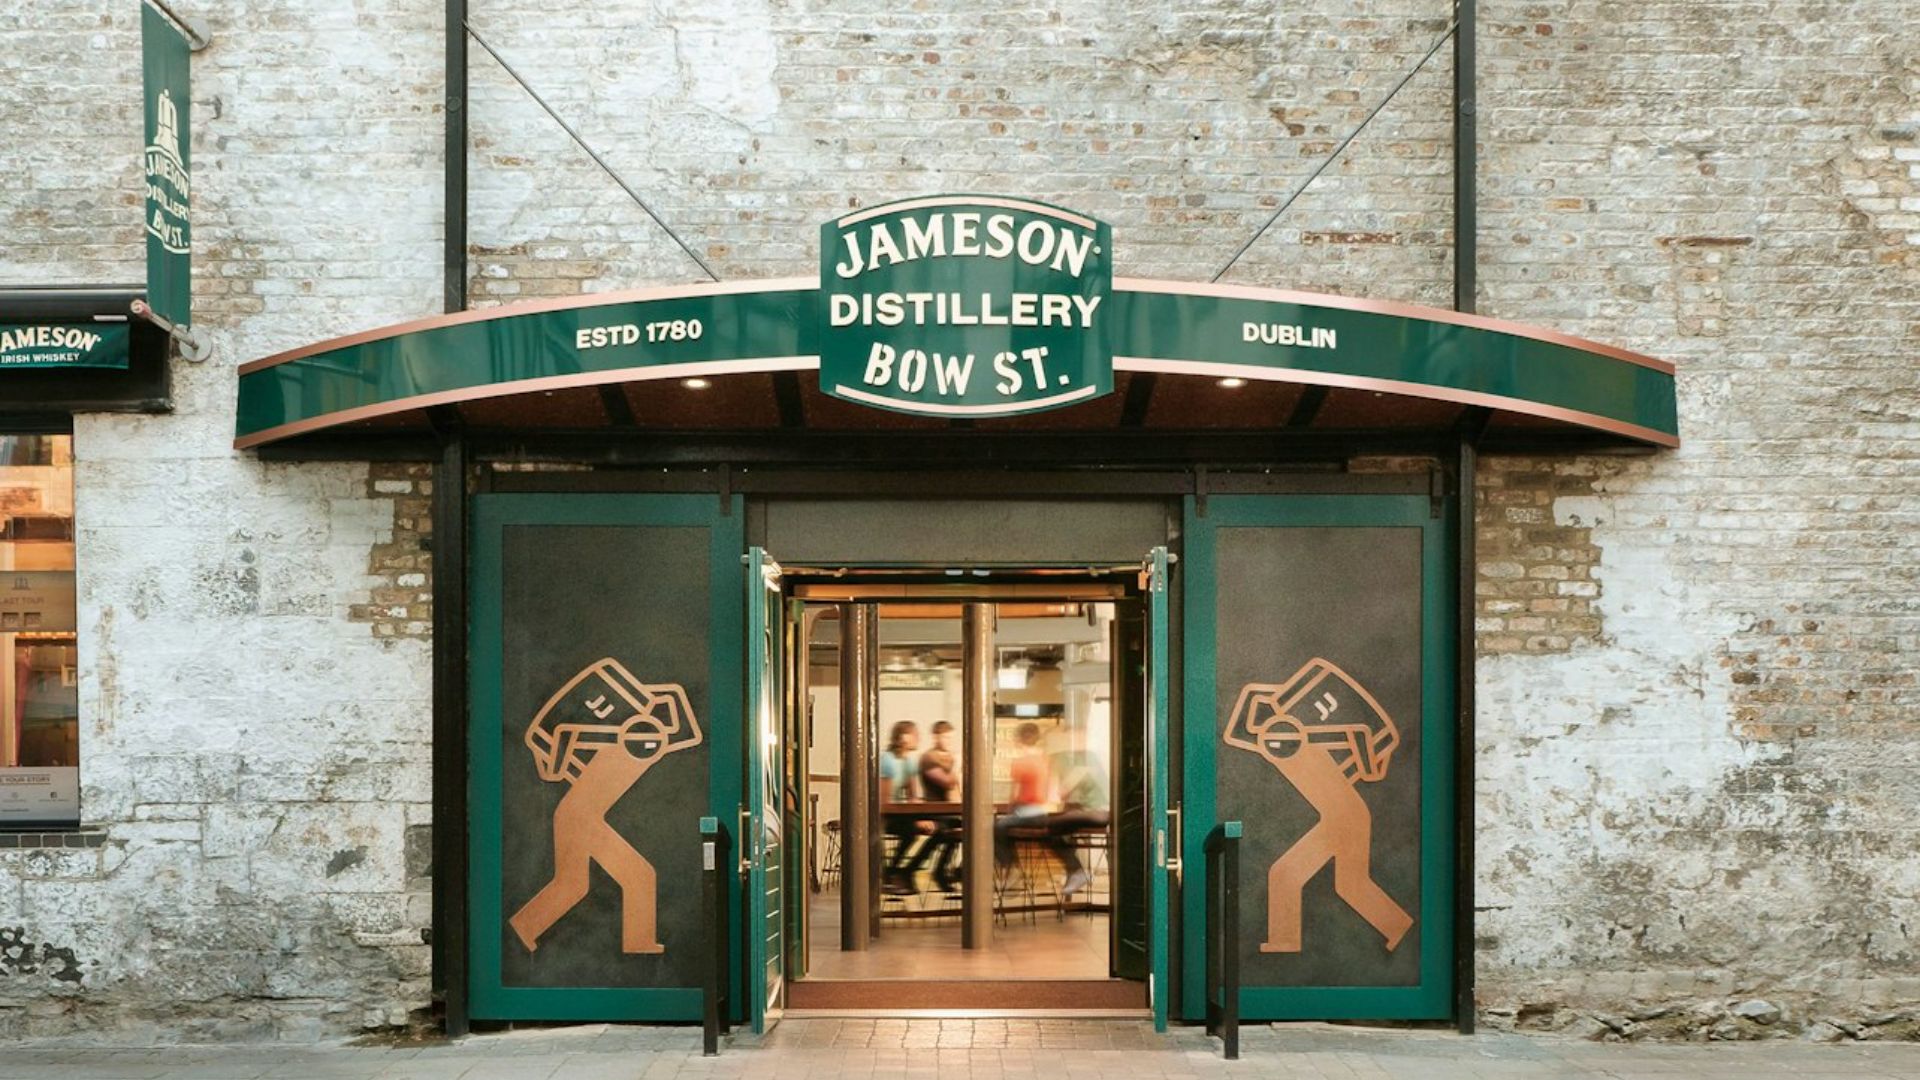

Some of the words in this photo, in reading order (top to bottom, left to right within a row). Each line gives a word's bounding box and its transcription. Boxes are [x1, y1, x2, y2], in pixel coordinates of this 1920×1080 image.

[153, 209, 171, 243] BW
[836, 212, 1094, 278] JAMESON
[830, 292, 1102, 328] DISTILLERY
[0, 326, 99, 353] AMESON
[576, 324, 640, 349] ESTD
[646, 319, 703, 342] 1780
[1242, 322, 1337, 349] DUBLIN
[1, 354, 30, 363] IRISH
[33, 352, 80, 362] WHISKEY
[863, 342, 975, 396] BOW
[993, 346, 1070, 395] ST.
